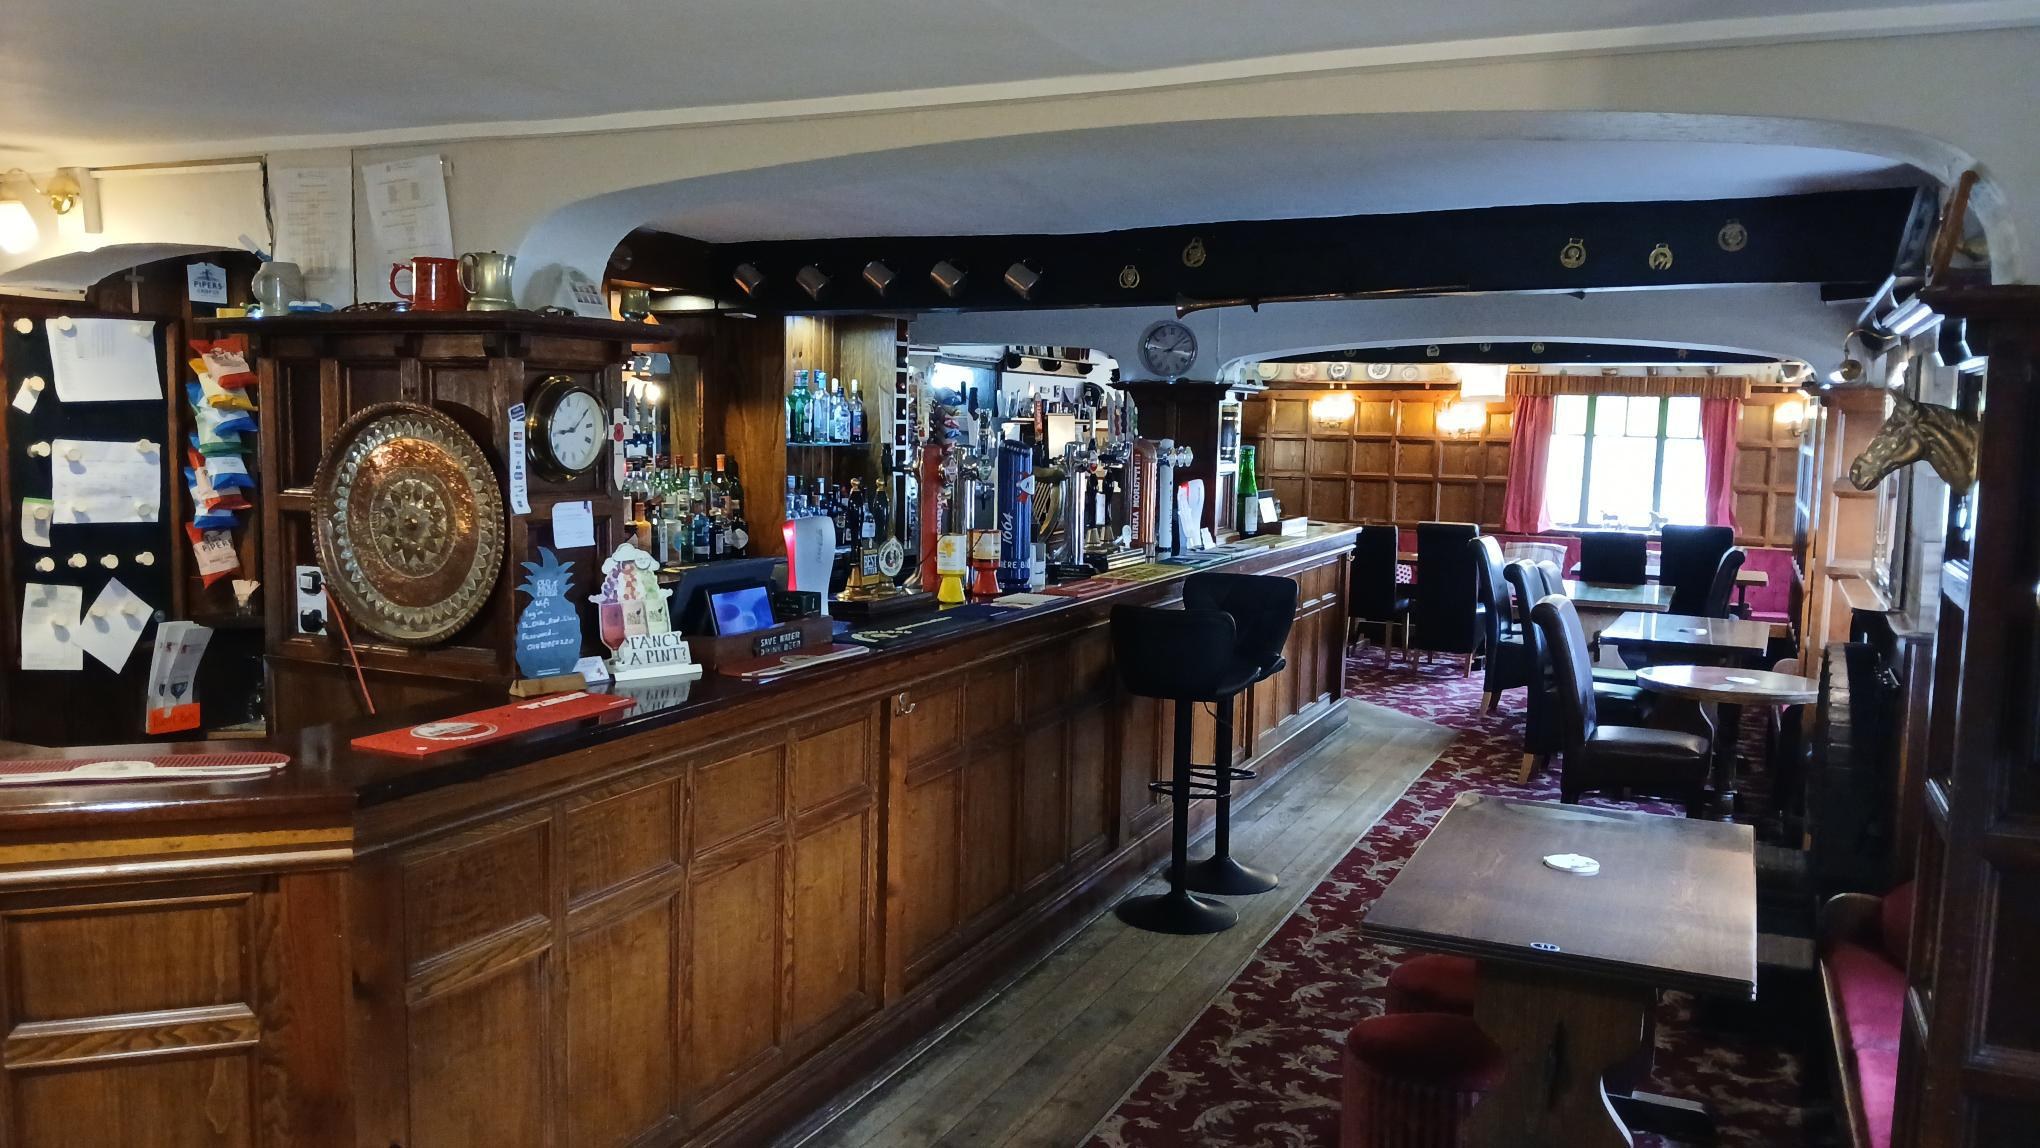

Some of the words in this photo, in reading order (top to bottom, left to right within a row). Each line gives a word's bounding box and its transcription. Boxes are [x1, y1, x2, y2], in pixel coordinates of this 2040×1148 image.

[193, 281, 223, 290] PIPERS
[1133, 466, 1141, 508] MORETTI
[1002, 512, 1014, 545] 1664
[1131, 511, 1139, 540] BIRRA
[630, 633, 682, 650] FANCY
[760, 636, 777, 647] SAVE
[779, 631, 801, 643] WATER
[630, 652, 642, 665] A
[646, 648, 687, 664] PINT?
